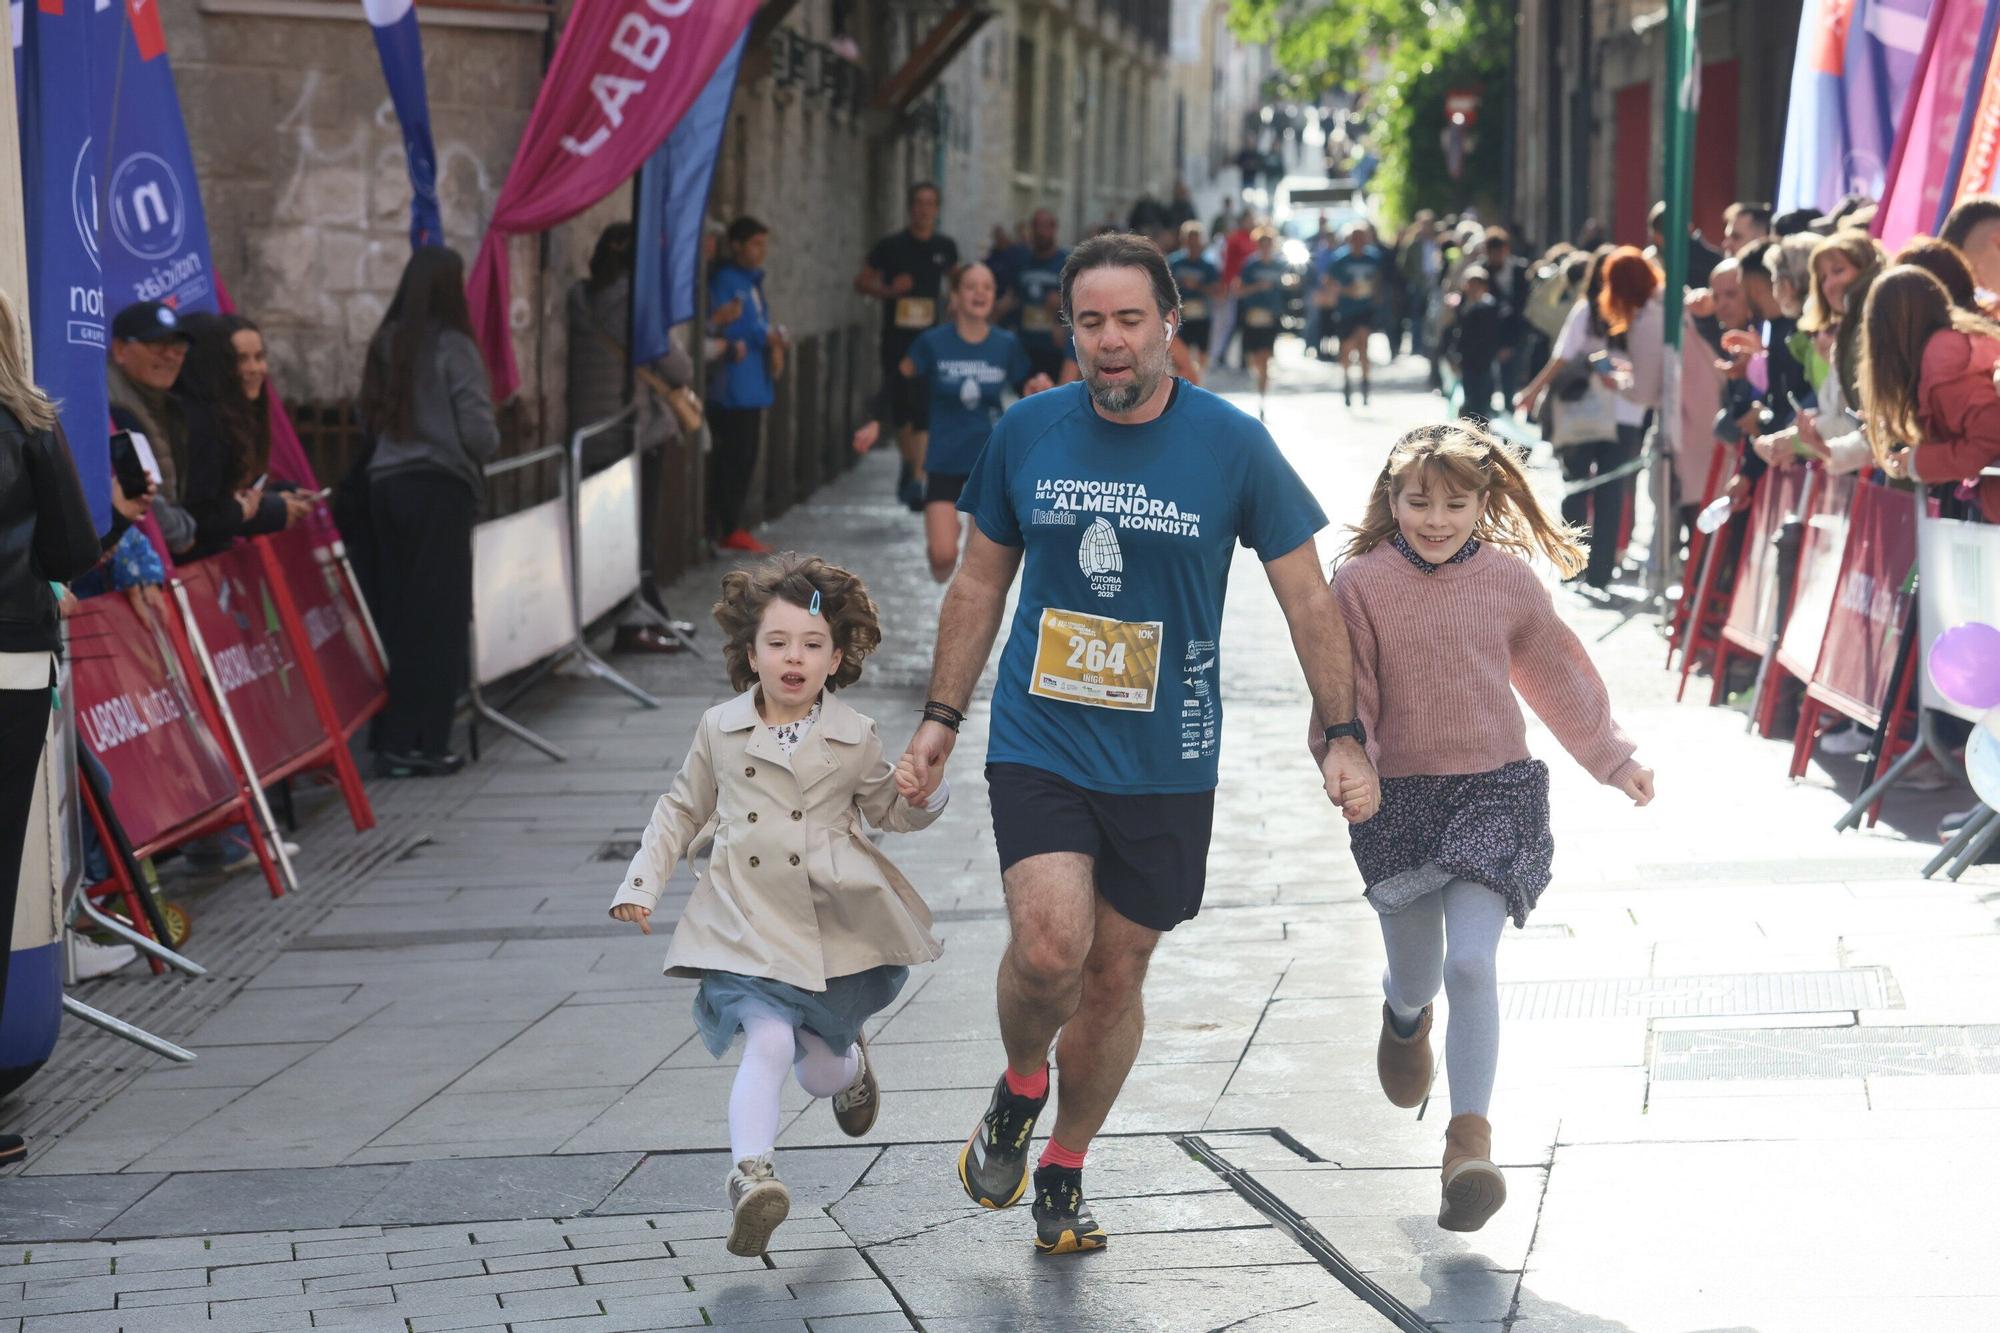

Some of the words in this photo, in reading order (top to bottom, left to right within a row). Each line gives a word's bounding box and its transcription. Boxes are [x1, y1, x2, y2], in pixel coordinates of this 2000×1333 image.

[1036, 479, 1051, 491] LA
[1053, 479, 1147, 497] CONQUISTA
[1035, 491, 1045, 499] DE
[1046, 491, 1057, 499] LA
[1053, 492, 1180, 520] ALMENDRA
[1180, 512, 1200, 523] REN
[1119, 514, 1200, 537] KONKISTA
[1090, 575, 1122, 584] VITORIA
[1090, 583, 1122, 592] GASTEIZ
[1097, 590, 1114, 598] 2025
[1138, 629, 1154, 639] 10K
[1066, 635, 1126, 675] 264
